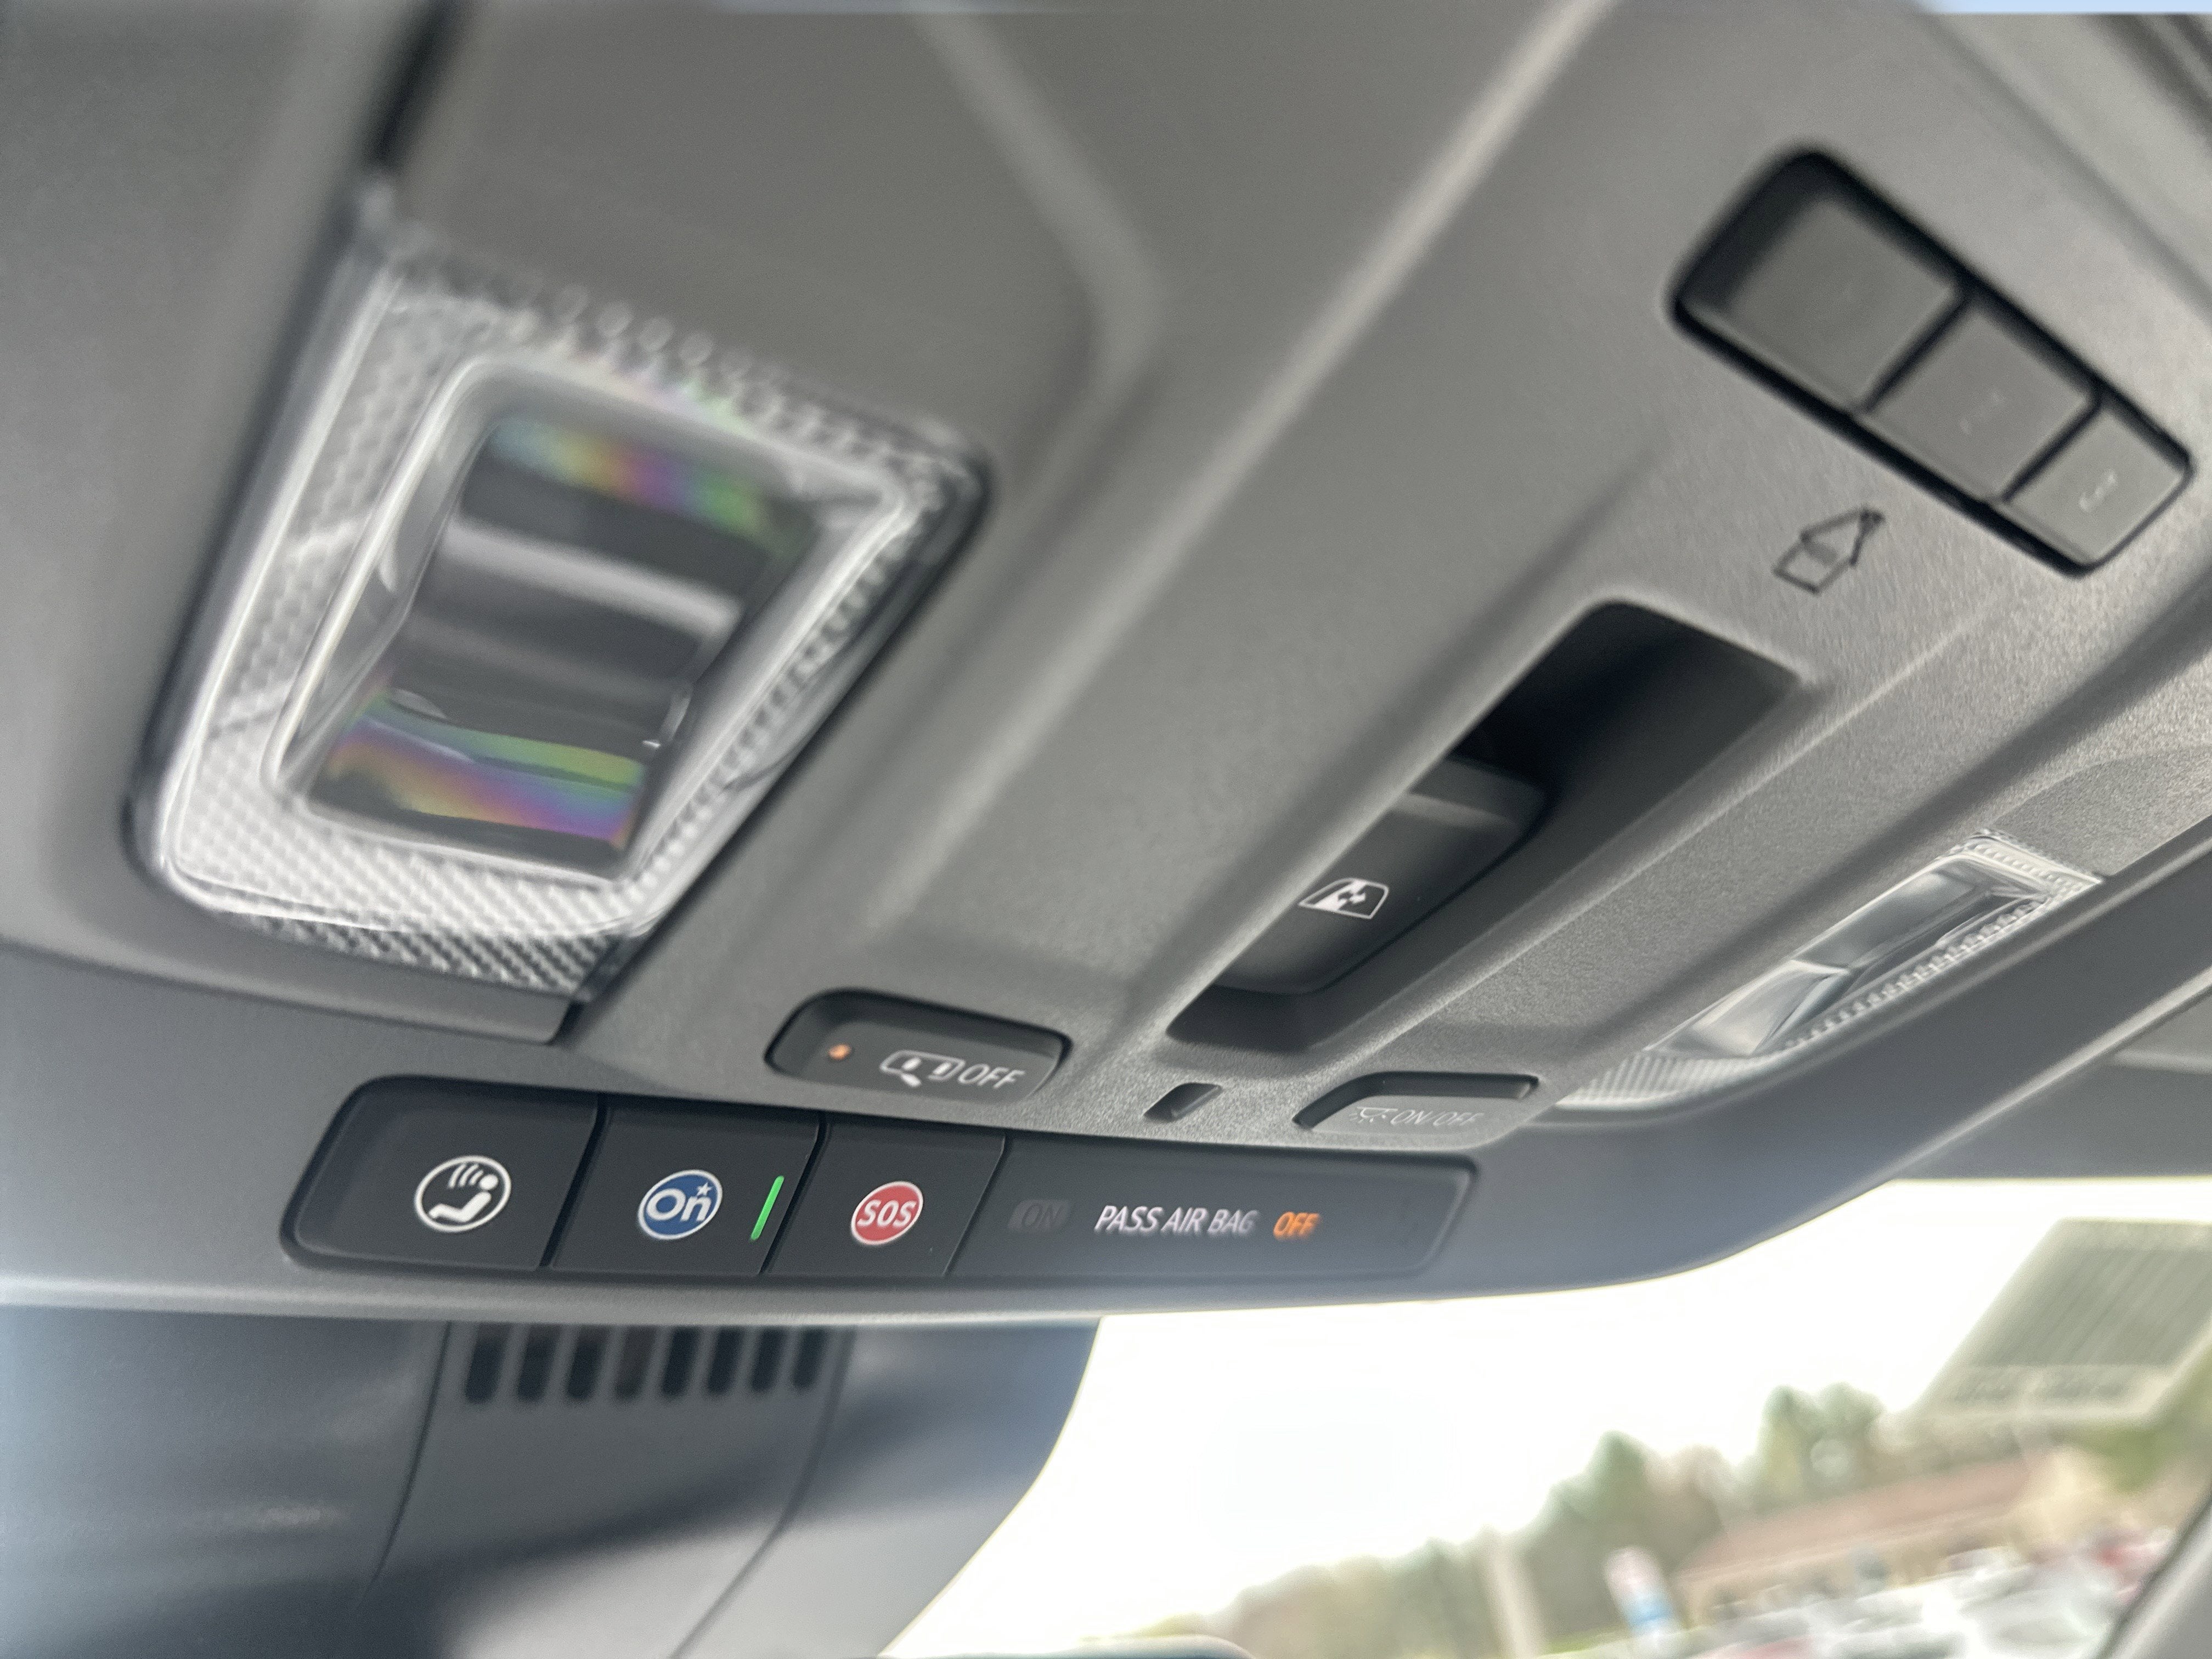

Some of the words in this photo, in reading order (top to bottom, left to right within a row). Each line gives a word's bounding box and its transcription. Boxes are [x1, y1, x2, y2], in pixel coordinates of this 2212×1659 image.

[957, 1063, 1025, 1089] OFF
[646, 1186, 713, 1222] On
[857, 1200, 917, 1228] SOS
[1021, 1203, 1064, 1229] ON
[1094, 1205, 1163, 1233] PASS
[1160, 1207, 1209, 1234] AIR
[1207, 1209, 1260, 1237] BAG
[1272, 1211, 1320, 1239] OFF
